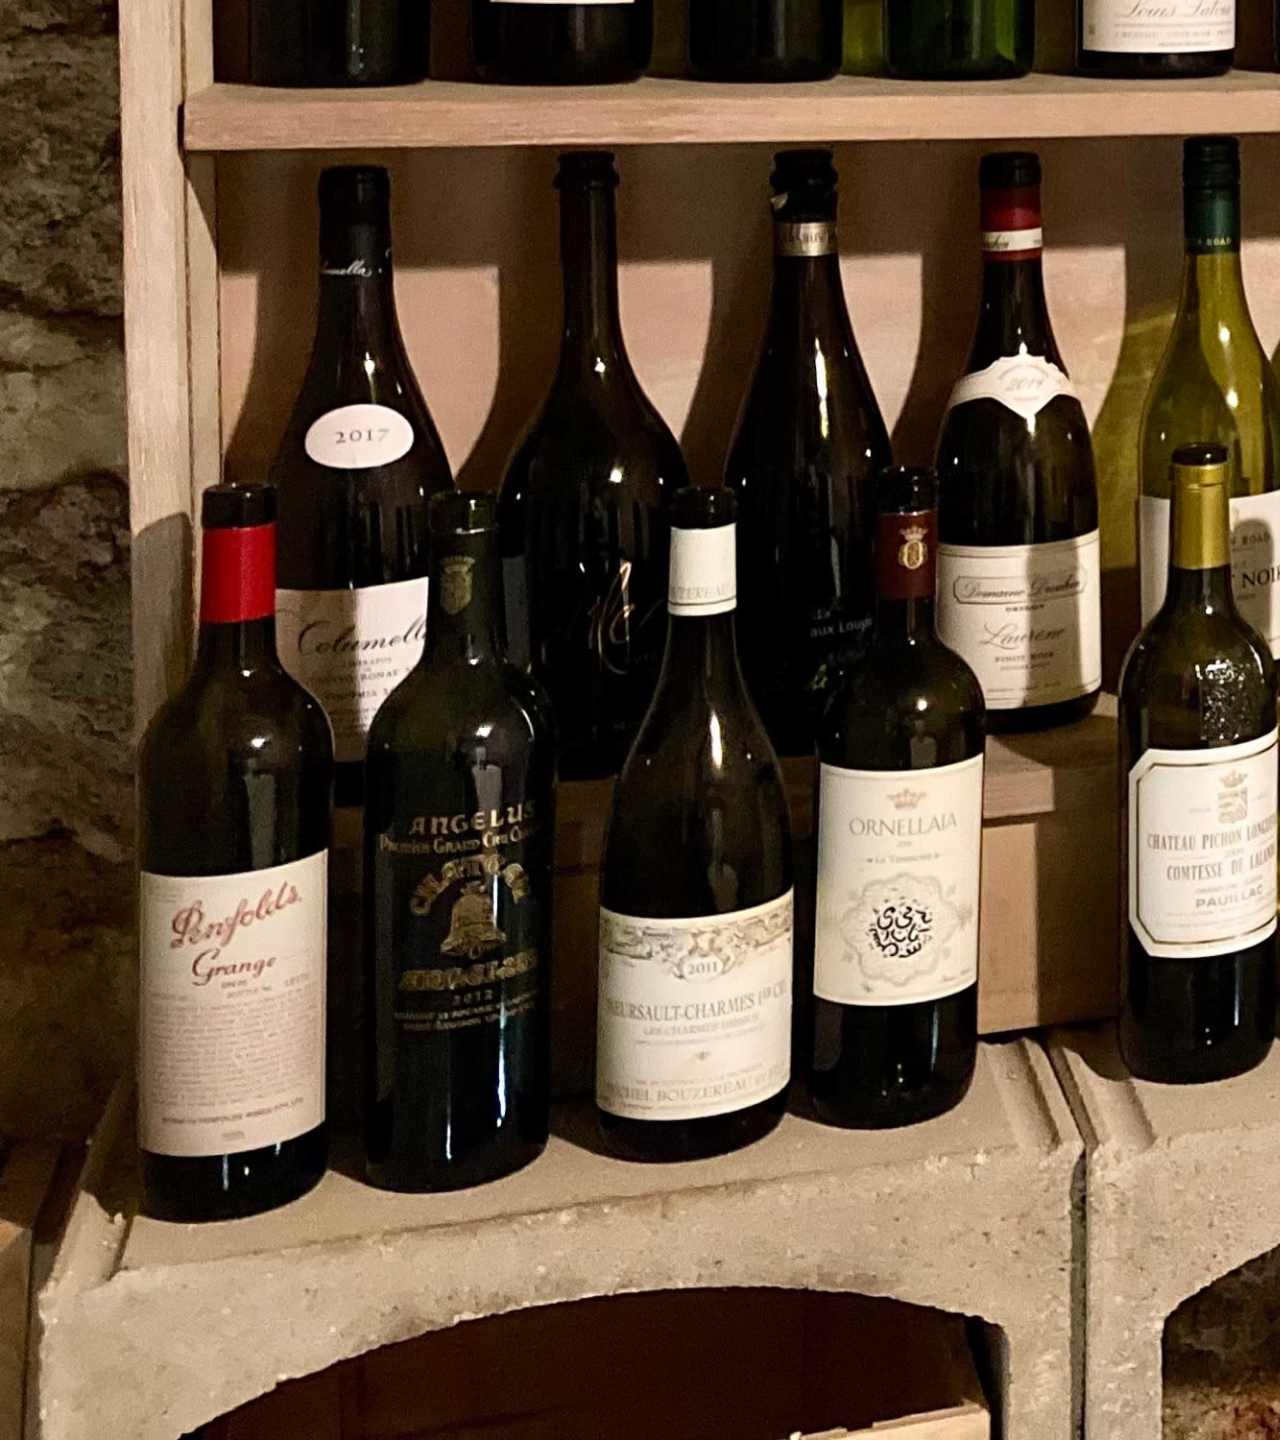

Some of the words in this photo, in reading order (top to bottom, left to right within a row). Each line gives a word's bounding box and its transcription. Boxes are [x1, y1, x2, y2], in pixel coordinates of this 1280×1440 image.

[335, 426, 390, 446] 2017
[409, 802, 536, 837] ANGELUS
[848, 813, 959, 838] ORNELLAIA
[1166, 862, 1223, 881] COMTESSE
[1195, 885, 1264, 909] PAUILLAC
[169, 881, 302, 950] Penfolds
[191, 946, 278, 987] Grange
[686, 960, 720, 976] 2011
